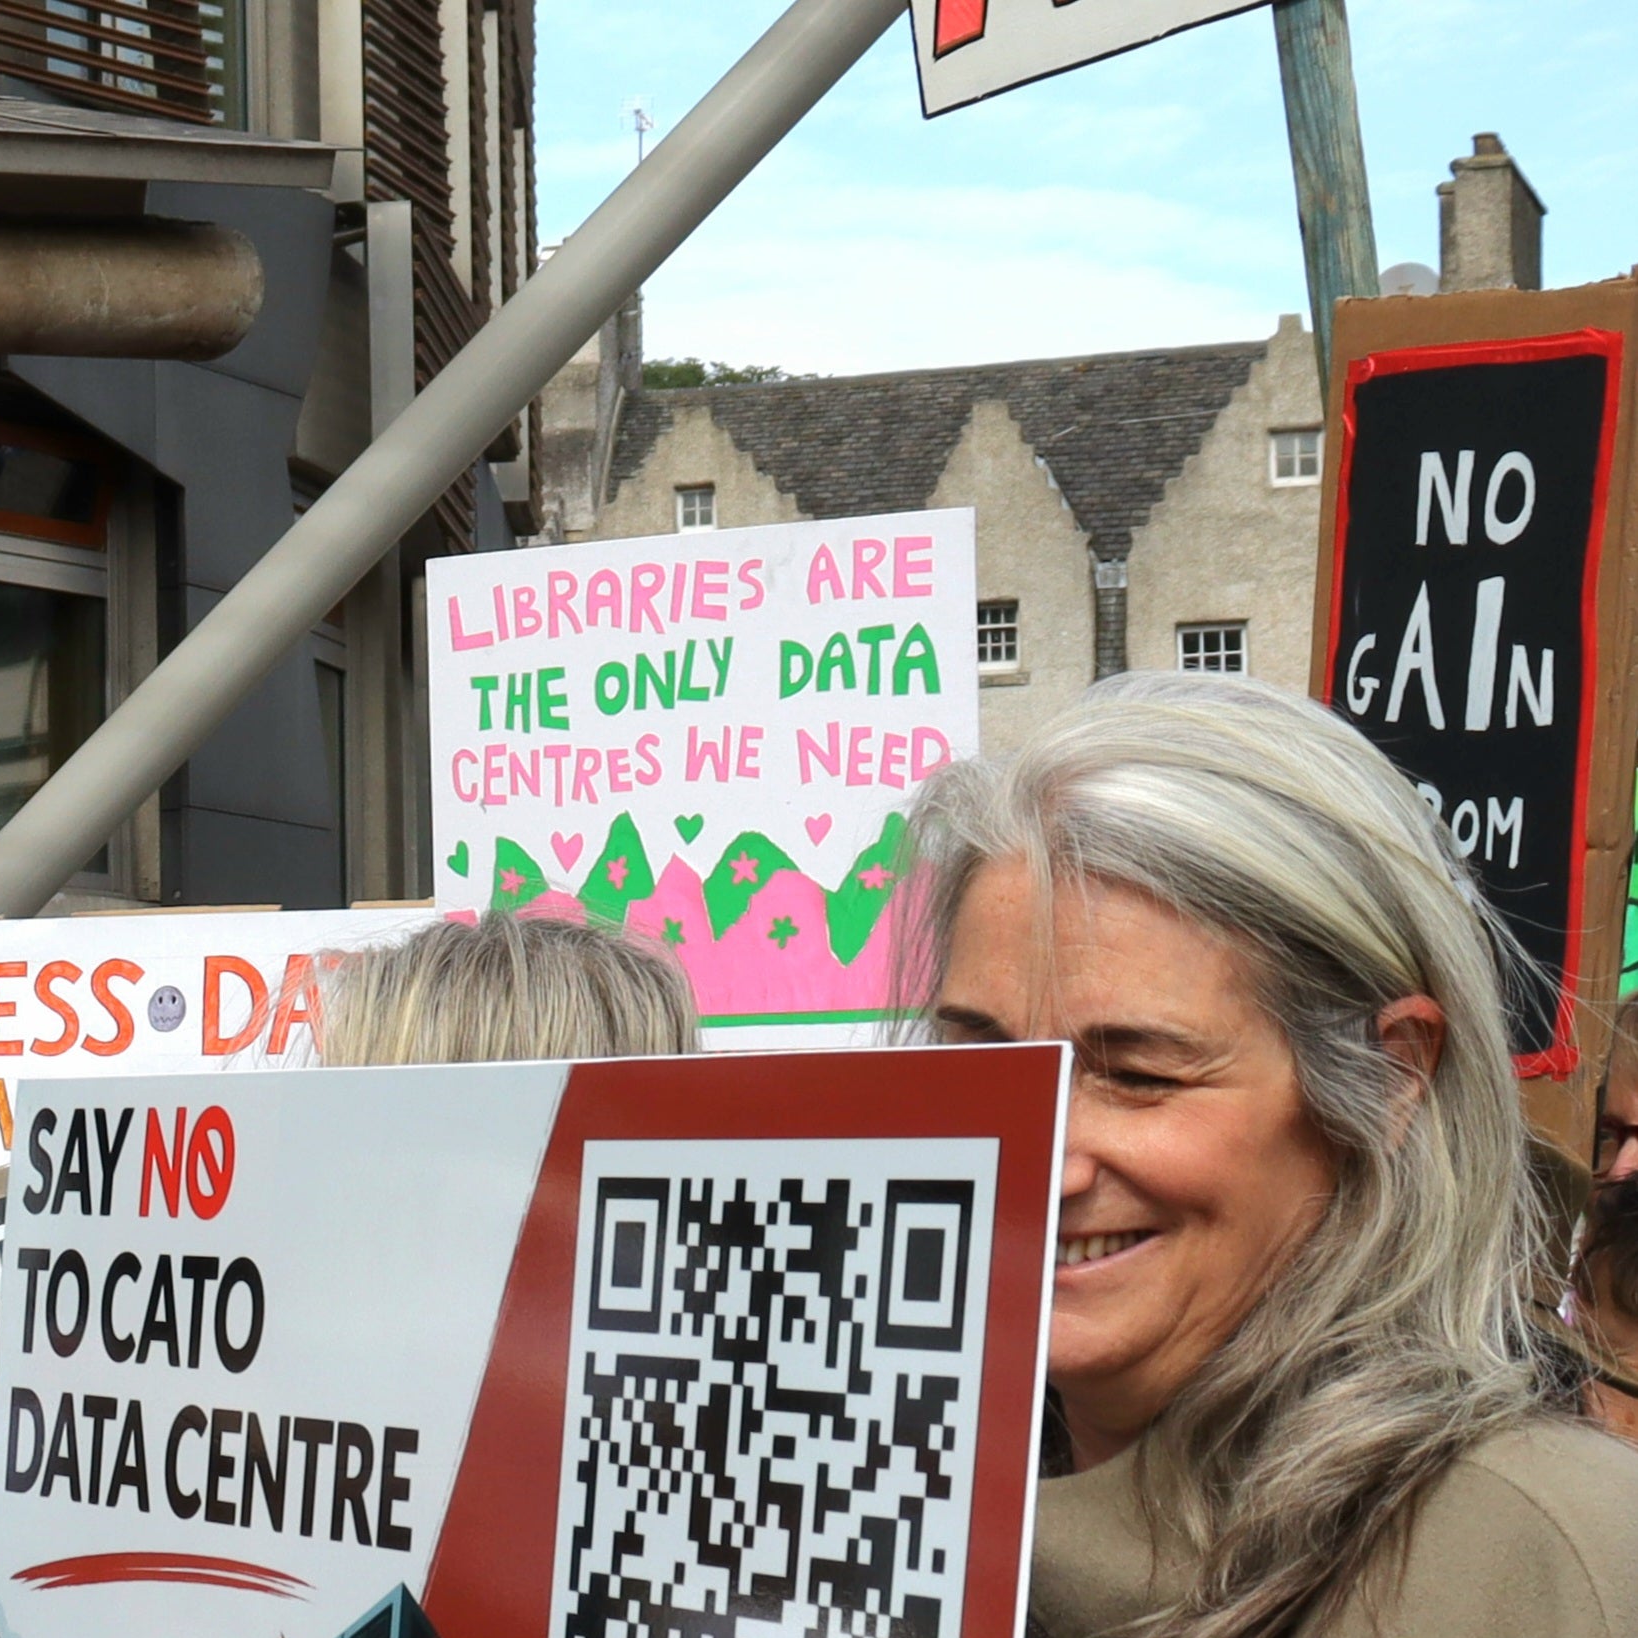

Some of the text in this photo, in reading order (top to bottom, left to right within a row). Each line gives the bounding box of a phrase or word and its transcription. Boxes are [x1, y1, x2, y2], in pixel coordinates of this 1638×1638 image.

[1415, 449, 1535, 546] NO
[448, 534, 934, 652] LIBRARIES ARE
[470, 622, 941, 733] THE ONLY DATA
[1346, 577, 1554, 732] GAIN
[450, 721, 952, 807] CENTRES WE NEED
[23, 1107, 134, 1216] SAY
[138, 1104, 236, 1220] NO
[17, 1248, 264, 1373] TO CATO
[5, 1387, 419, 1553] DATA CENTRE
